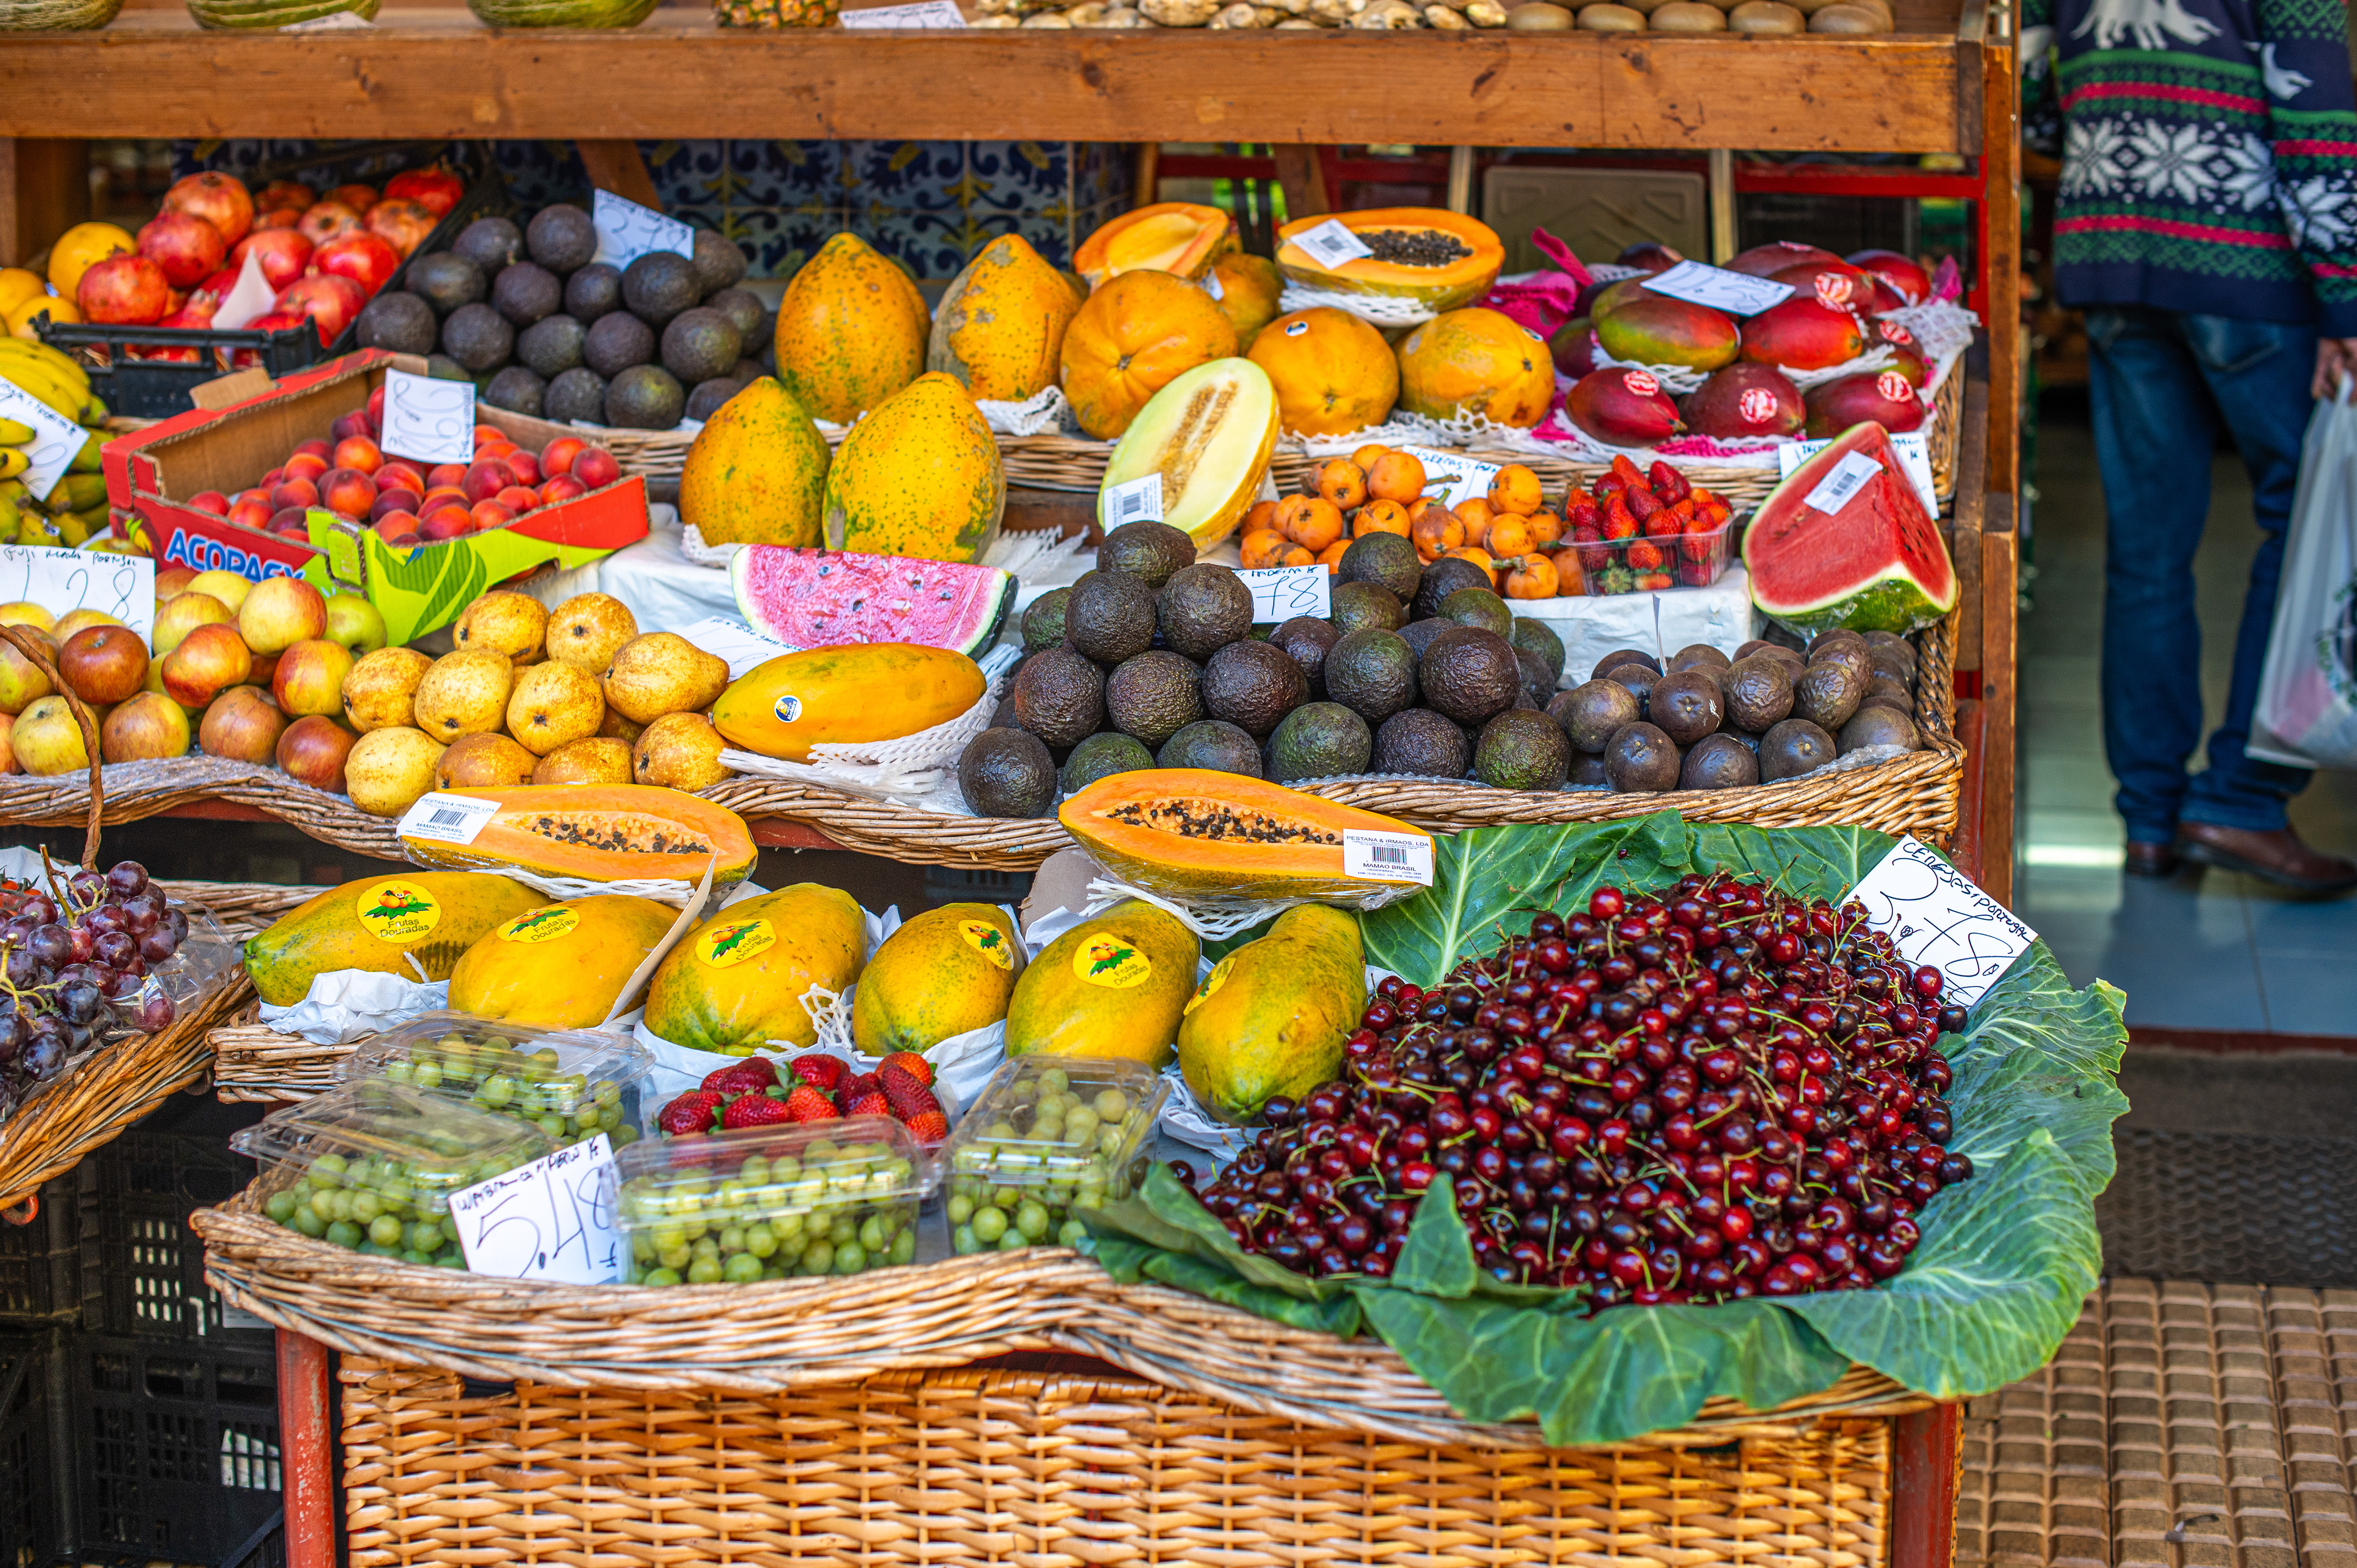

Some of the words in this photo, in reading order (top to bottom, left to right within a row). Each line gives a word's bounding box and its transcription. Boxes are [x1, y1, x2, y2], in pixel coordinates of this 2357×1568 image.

[787, 700, 797, 720] Madeira
[380, 924, 430, 937] Douradas
[387, 919, 419, 928] Frutas
[531, 920, 576, 941] Douradas
[534, 919, 564, 933] Frutas
[736, 934, 762, 953] Frutas
[736, 936, 773, 961] Douradas
[1114, 964, 1137, 977] Frutas
[1114, 966, 1148, 986] Douradas
